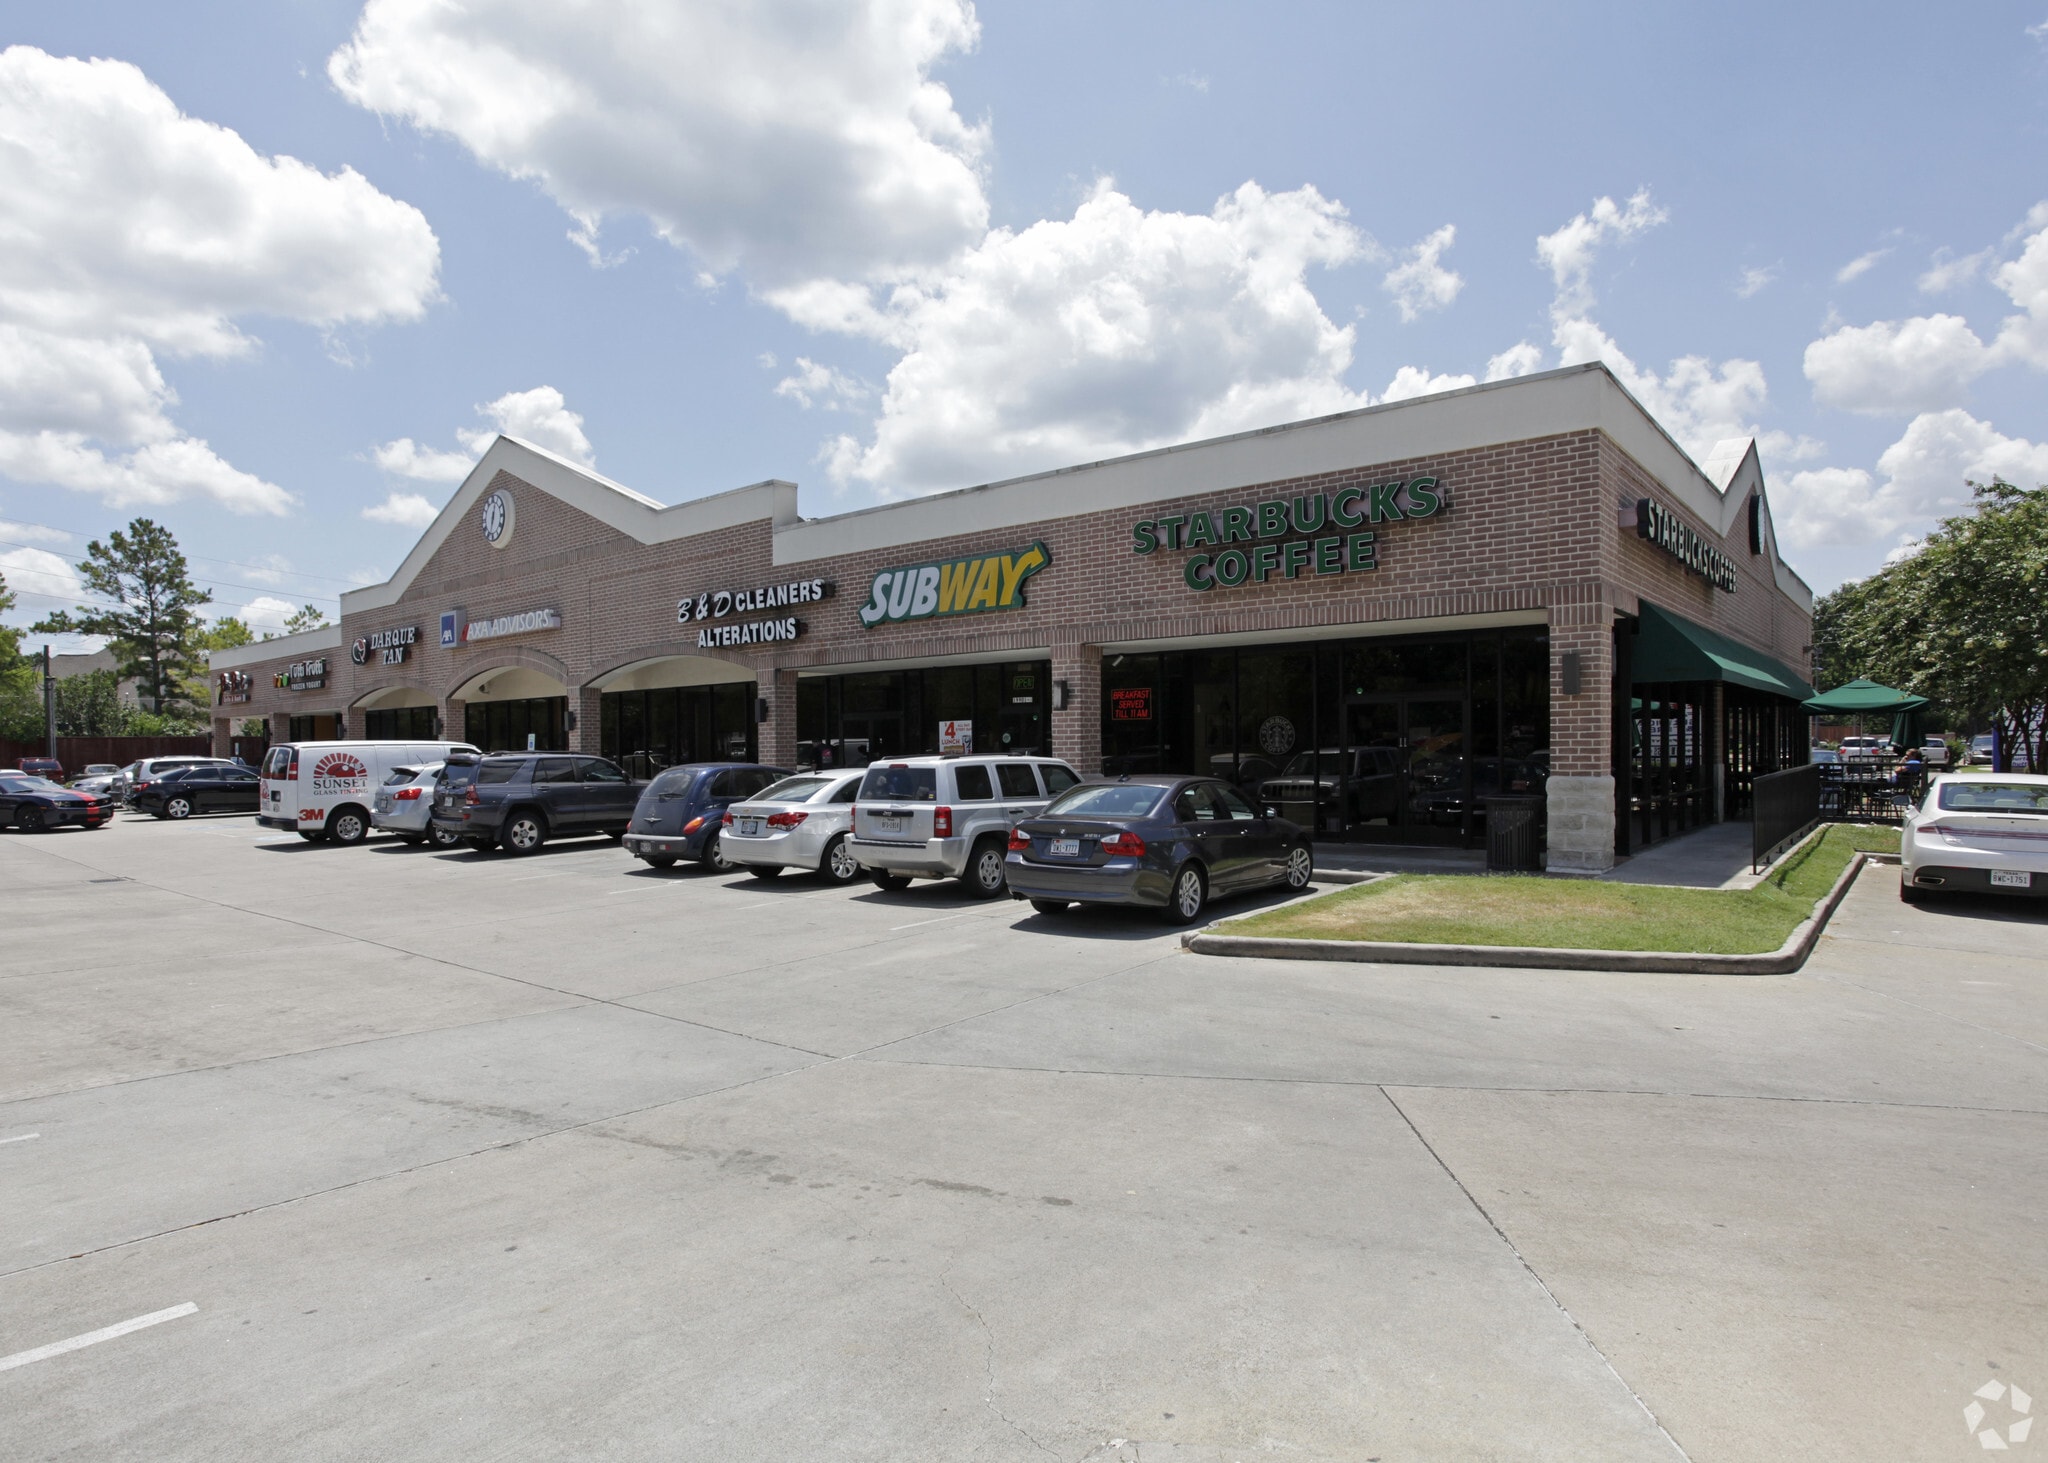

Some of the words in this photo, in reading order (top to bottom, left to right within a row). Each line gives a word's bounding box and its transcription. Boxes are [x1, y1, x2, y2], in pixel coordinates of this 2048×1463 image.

[1132, 476, 1439, 555] STARBUCKS
[1648, 498, 1708, 575] STARBUCKS
[1709, 546, 1737, 593] COFFEE
[1183, 532, 1376, 591] COFFEE
[860, 546, 1046, 624] SUBWAY
[677, 597, 692, 623] B
[695, 593, 709, 621] &
[711, 590, 735, 618] D
[735, 578, 825, 611] CLEANERS
[467, 621, 489, 640] AXA
[491, 609, 549, 635] ADVISORS
[697, 618, 797, 648] ALTERATIONS
[370, 627, 415, 649] DARQUE
[383, 647, 403, 665] TAN
[306, 680, 321, 689] YOGURT
[1112, 689, 1149, 700] BREAKFAST
[1115, 709, 1128, 718] TILL
[1136, 708, 1148, 717] AM
[1119, 699, 1145, 709] SERVED
[313, 778, 367, 790] SUNSET
[299, 808, 324, 821] 3M
